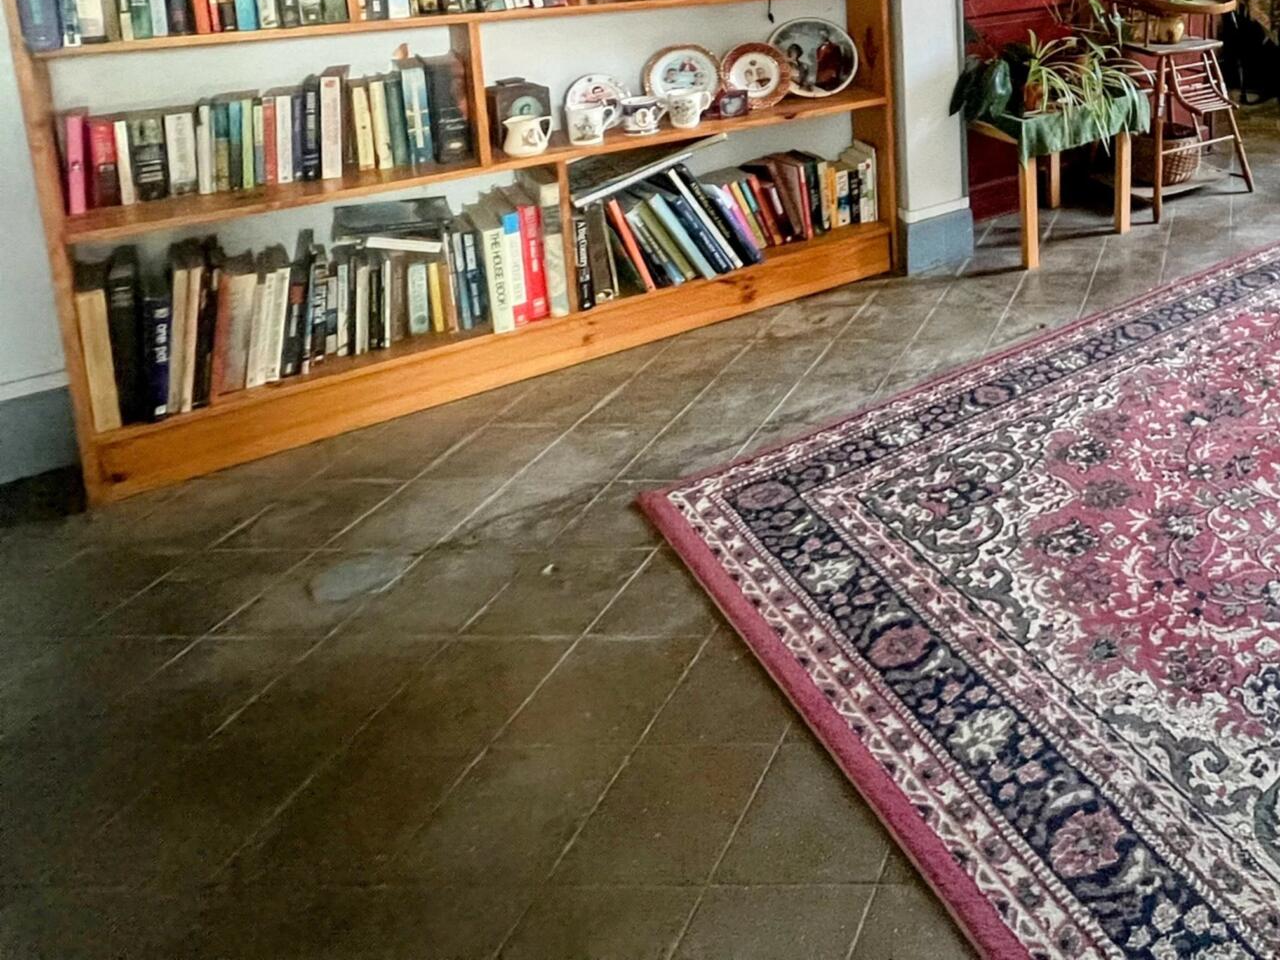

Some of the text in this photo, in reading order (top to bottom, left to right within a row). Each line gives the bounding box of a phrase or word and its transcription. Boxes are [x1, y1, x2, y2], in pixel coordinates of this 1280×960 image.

[490, 232, 507, 305] THE HOUSE BOOK
